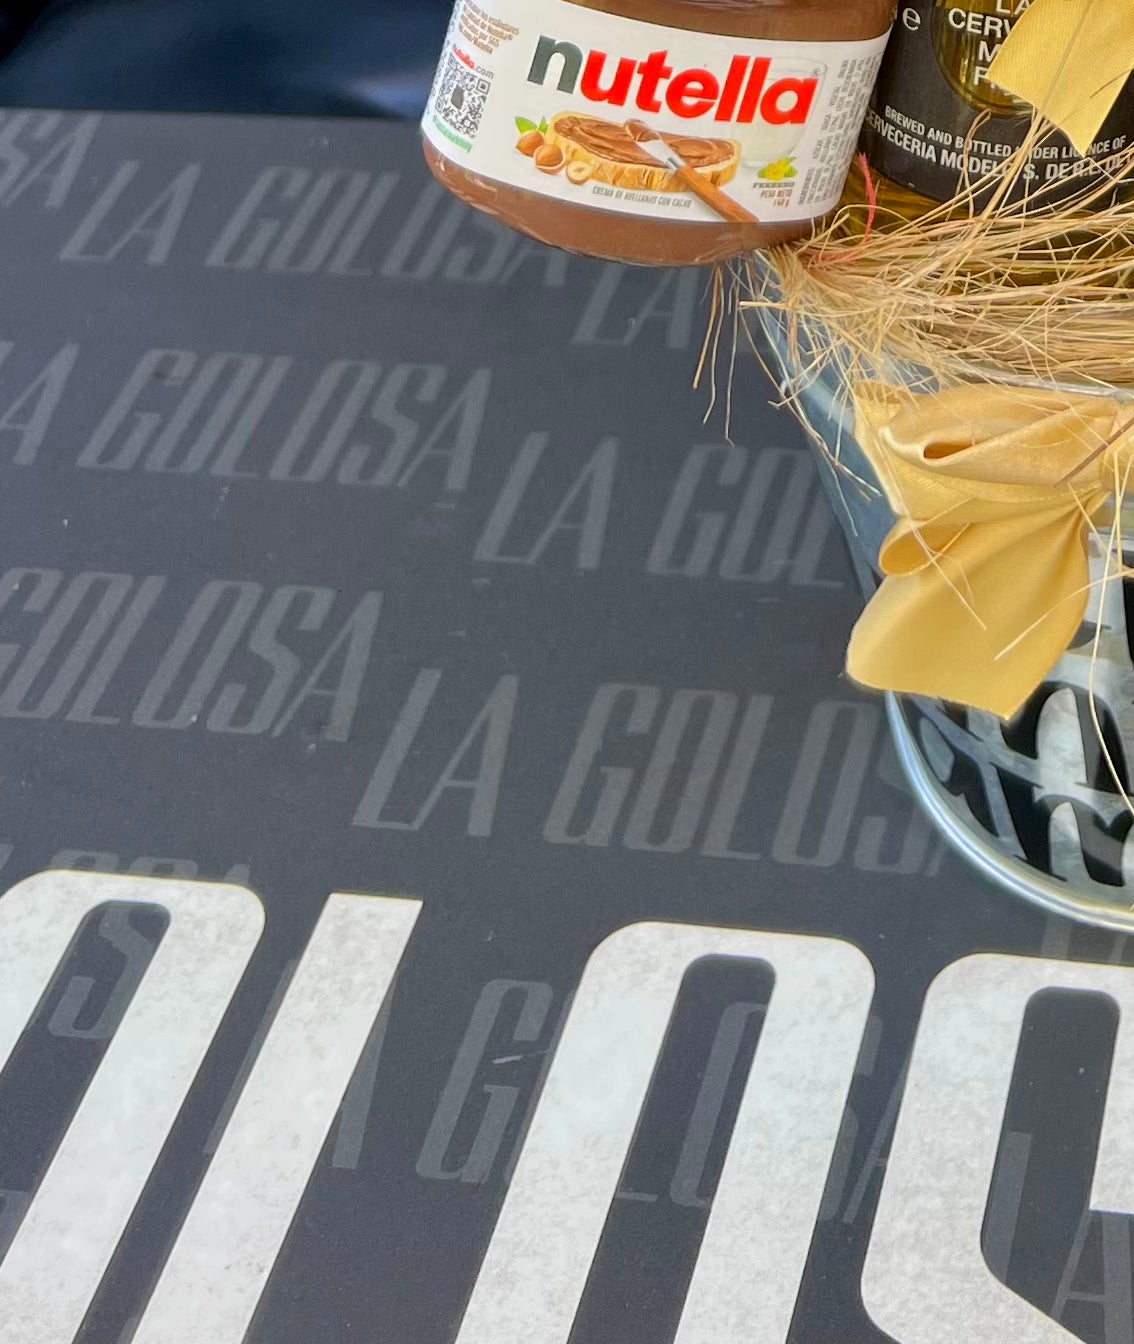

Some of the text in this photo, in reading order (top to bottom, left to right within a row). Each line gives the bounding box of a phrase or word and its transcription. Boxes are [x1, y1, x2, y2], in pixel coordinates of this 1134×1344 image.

[525, 33, 819, 127] nutella
[884, 105, 926, 136] BREWED
[927, 126, 953, 148] AND
[1112, 134, 1128, 151] OF
[60, 158, 200, 264] LA
[76, 346, 493, 495] GOLOSA
[473, 432, 620, 571] LA
[352, 668, 521, 839] LA
